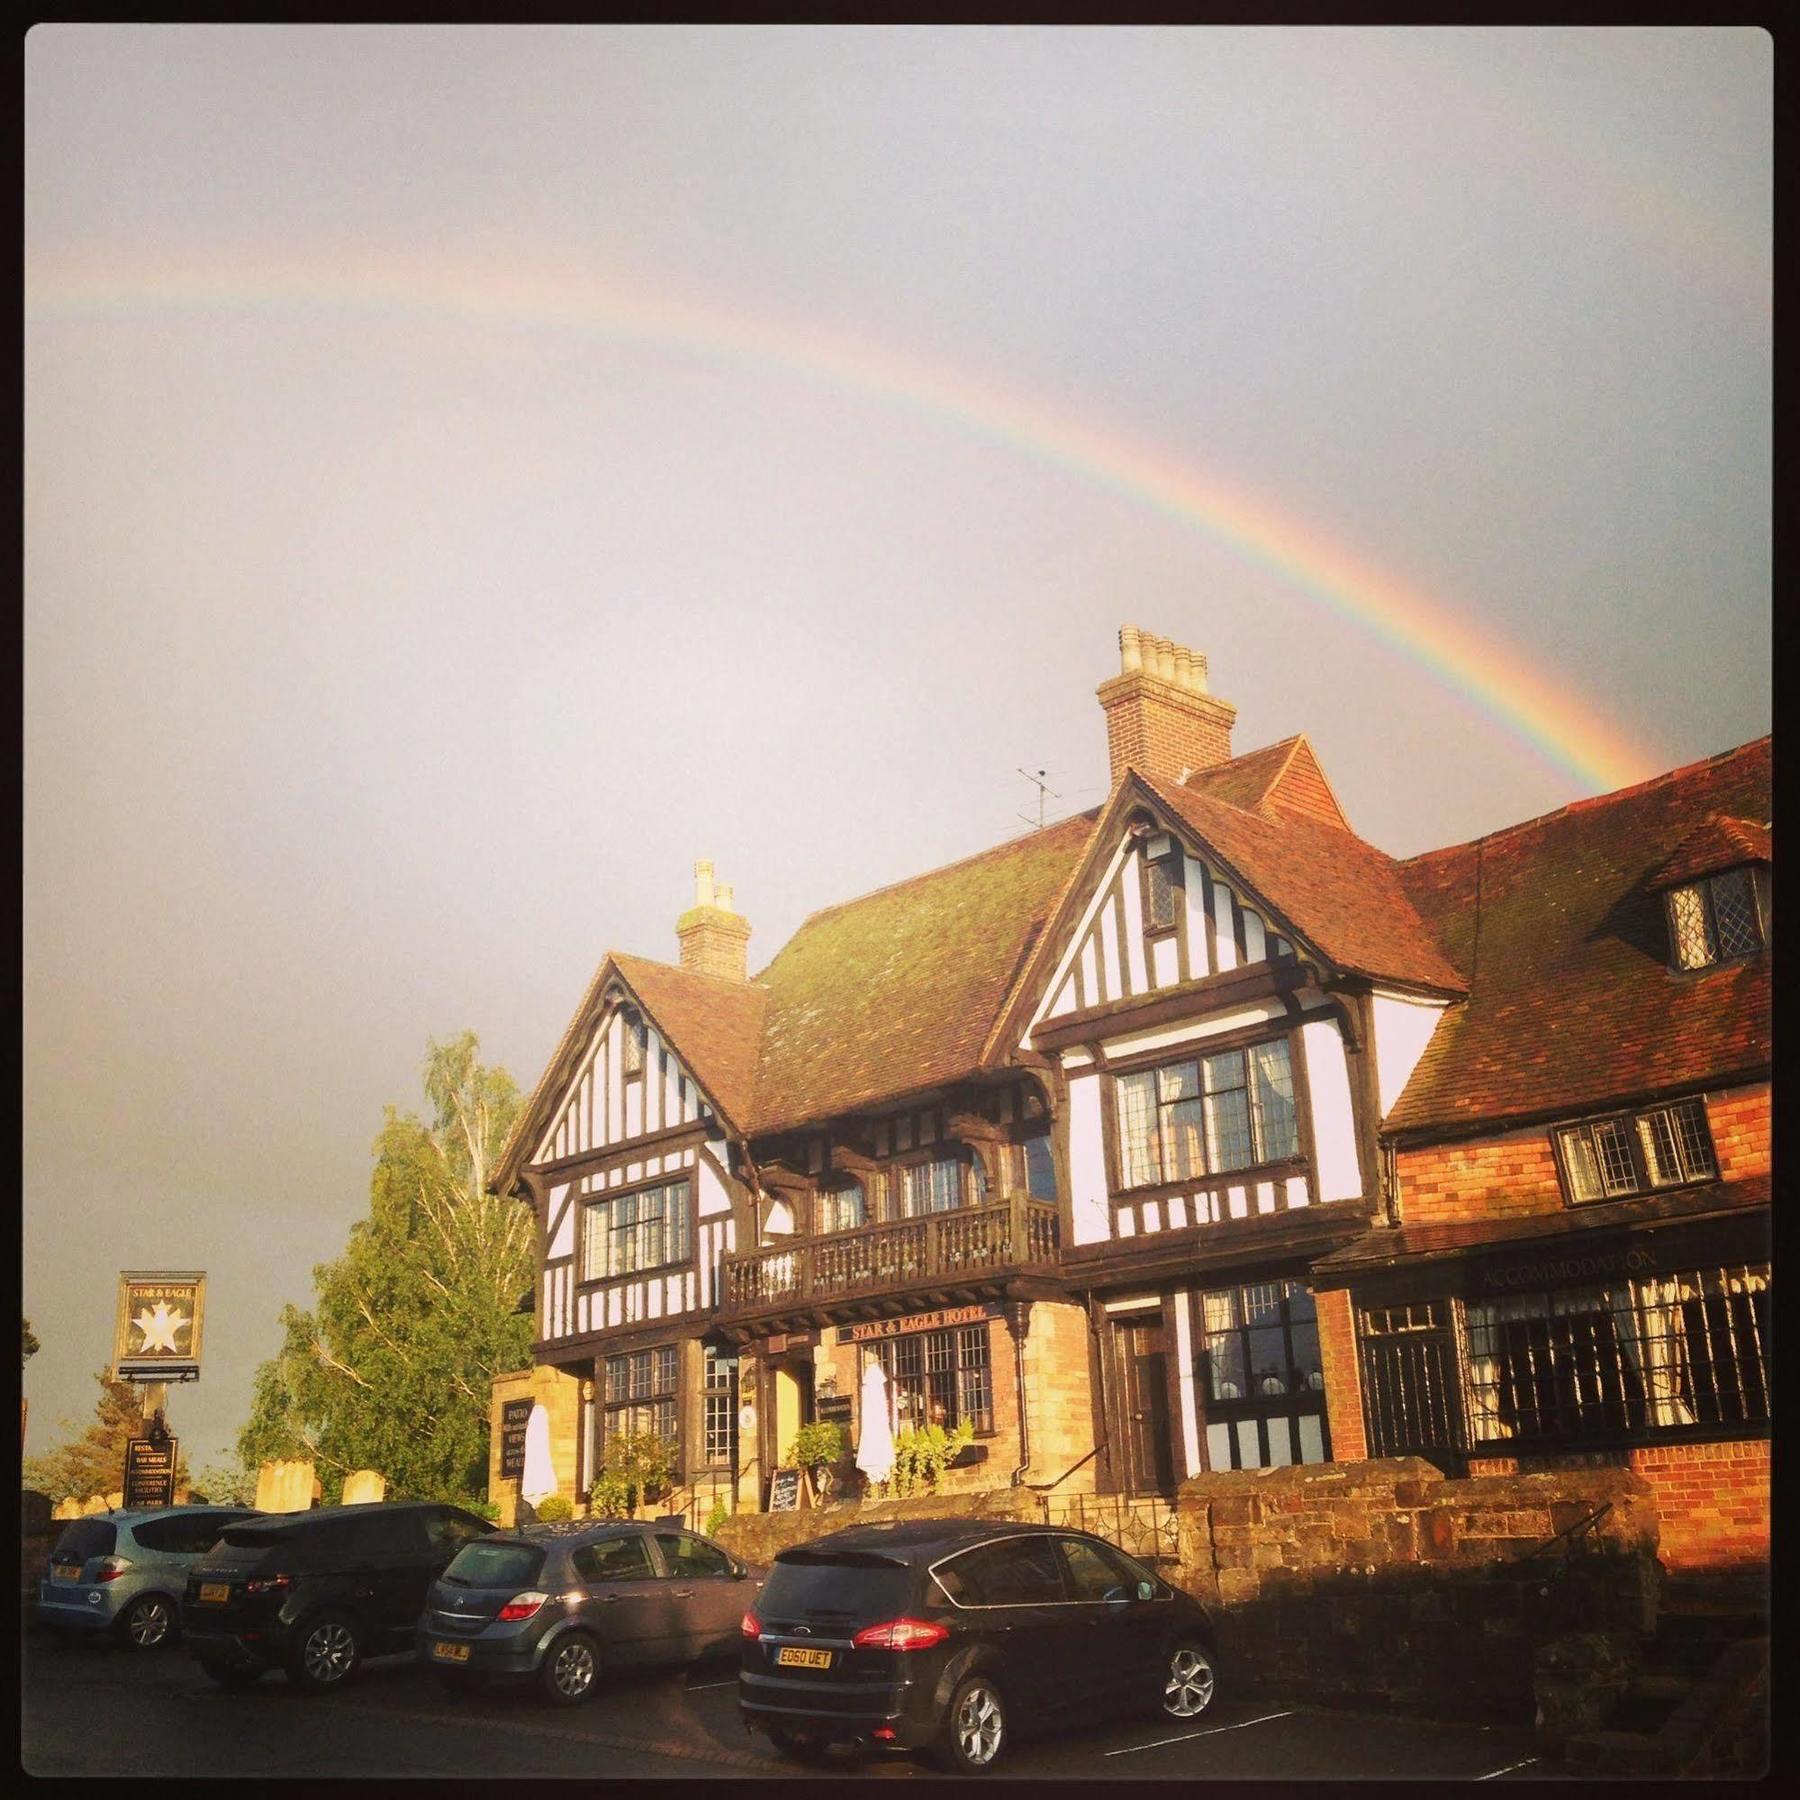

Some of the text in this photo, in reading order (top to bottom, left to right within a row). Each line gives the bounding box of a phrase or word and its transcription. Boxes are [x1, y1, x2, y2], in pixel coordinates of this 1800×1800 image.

[1482, 1249, 1657, 1287] ACCOMMODATON
[133, 1288, 192, 1297] STAR & EAGLE
[853, 1305, 986, 1339] STAR & EAGLE HOTEL
[808, 1652, 829, 1666] UET
